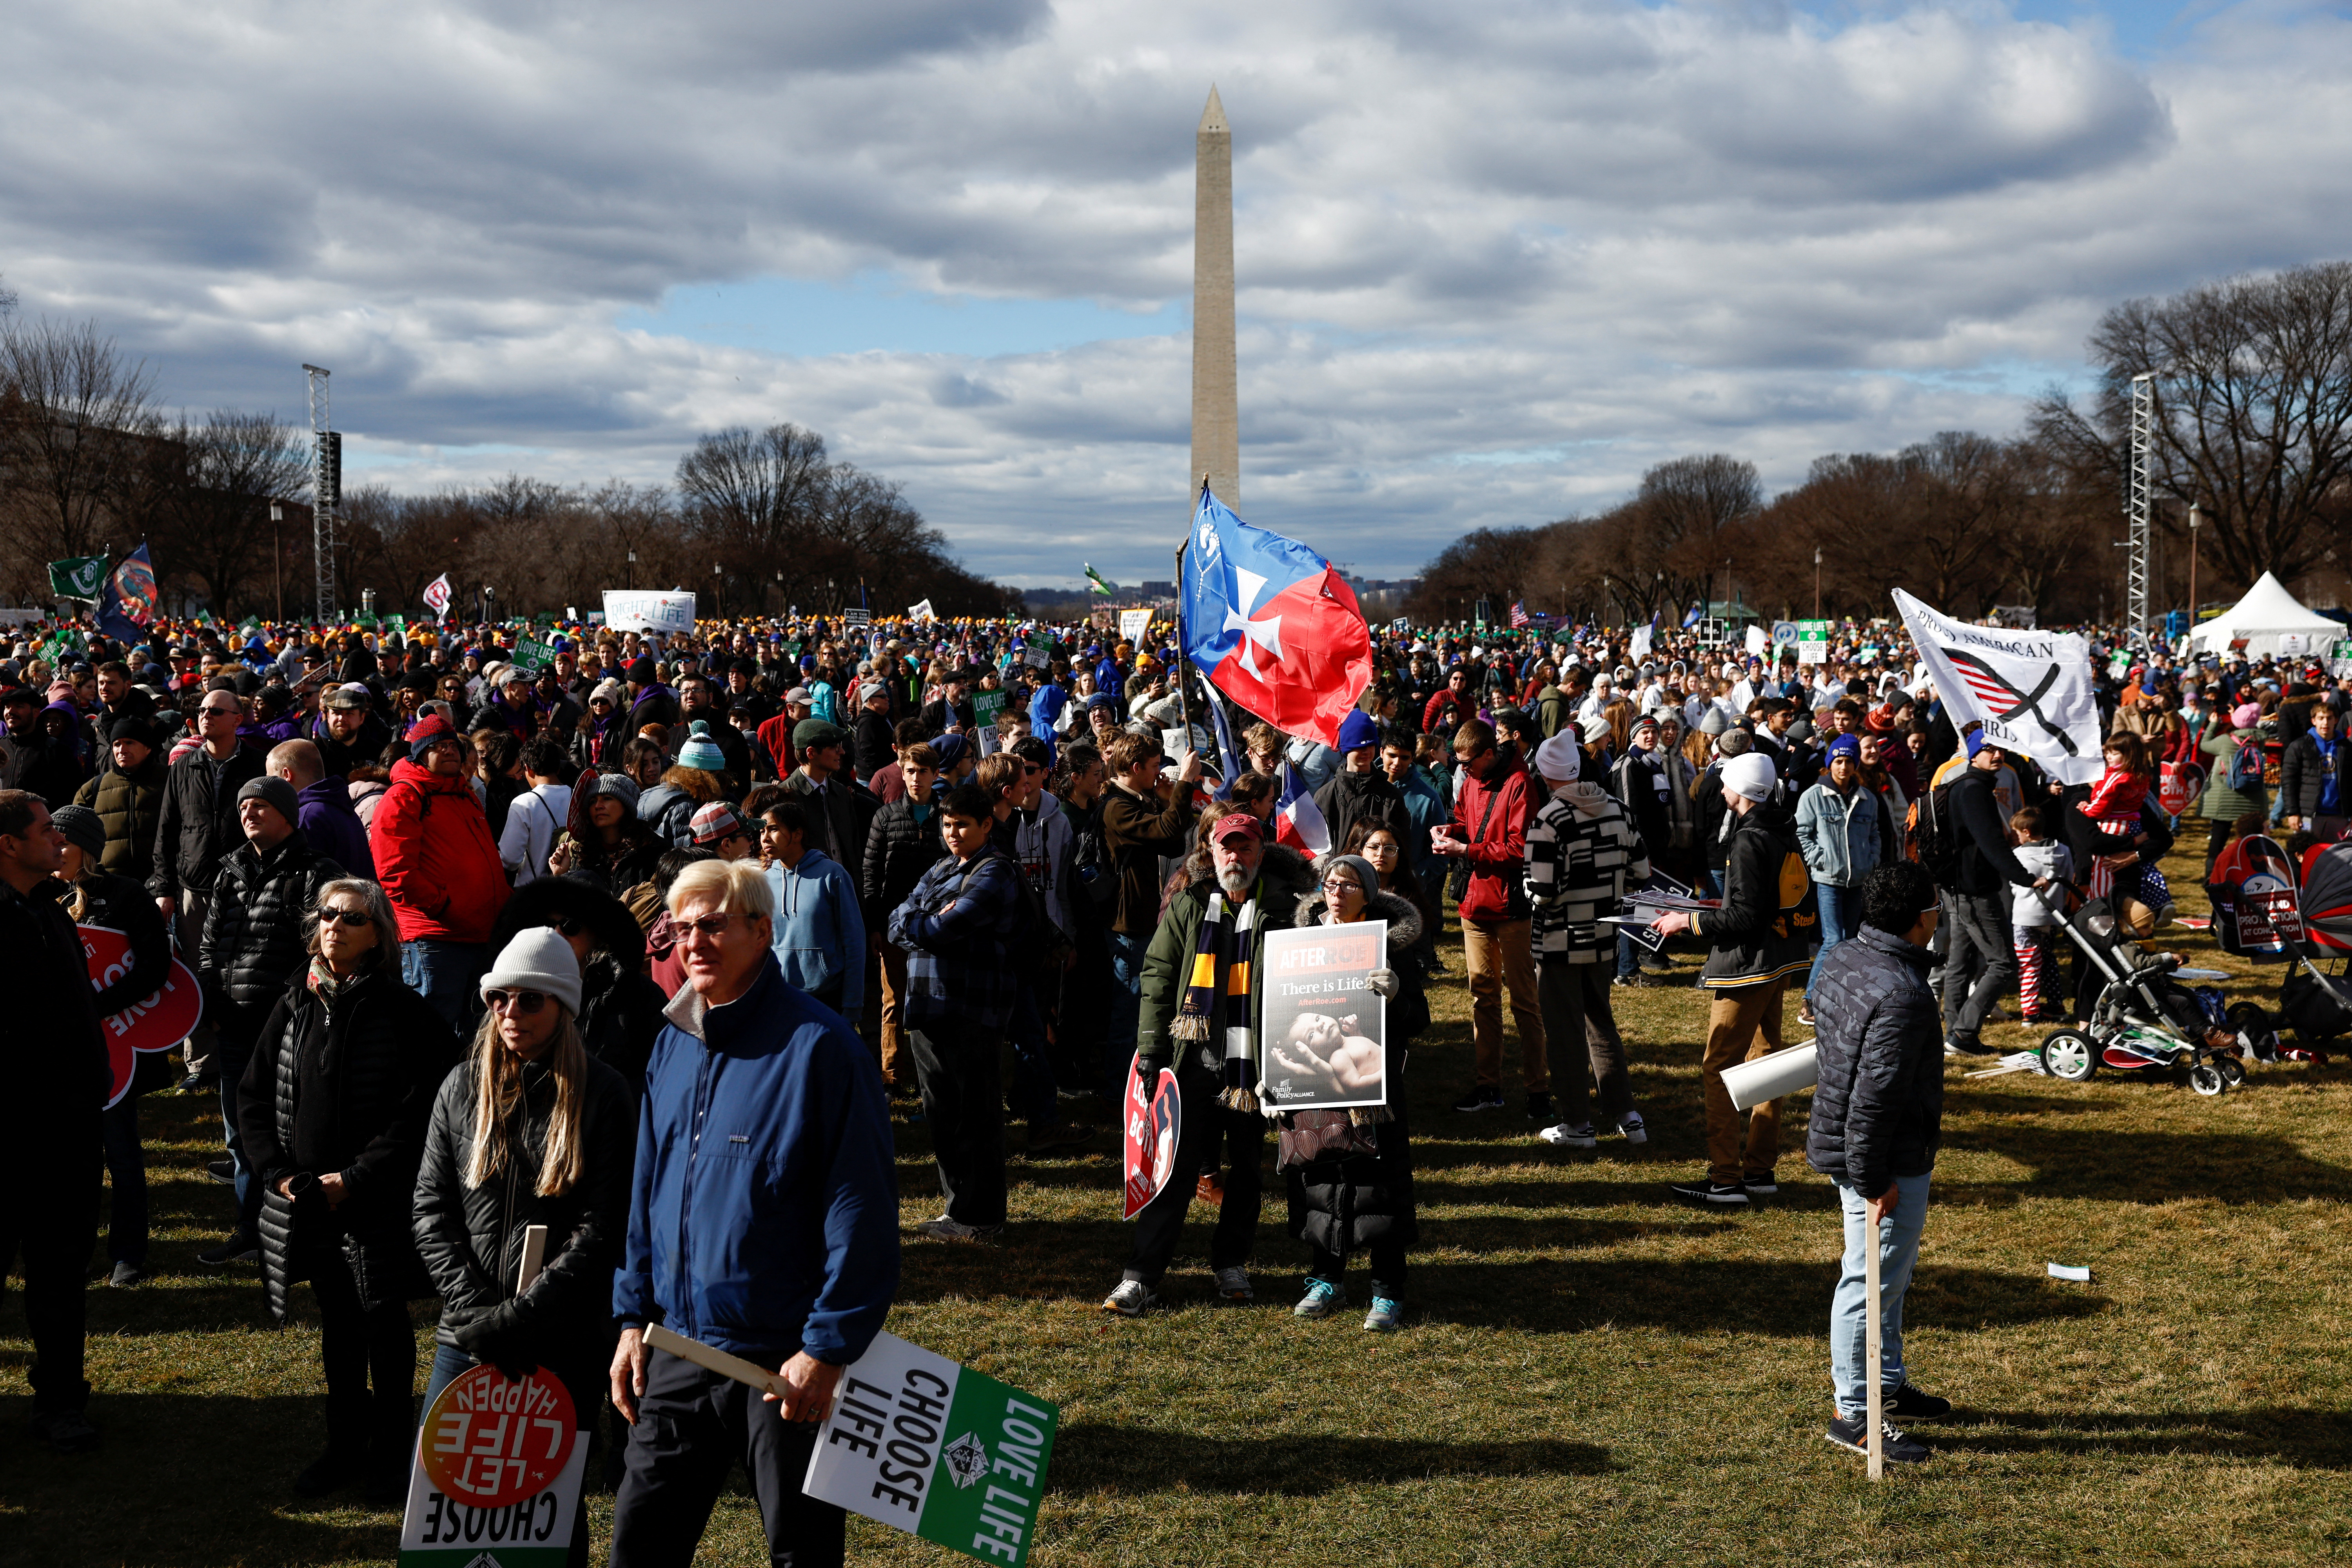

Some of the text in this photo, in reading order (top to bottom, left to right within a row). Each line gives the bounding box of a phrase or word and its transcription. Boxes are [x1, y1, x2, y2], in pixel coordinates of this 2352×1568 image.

[612, 600, 647, 622] RIGHT
[652, 601, 685, 623] LIFE
[1800, 621, 1825, 632] LOVE LIFE
[1918, 610, 1956, 642] PROUD
[1033, 632, 1054, 644] LOVE LIFE
[1803, 643, 1823, 652] CHOOSE
[518, 639, 555, 661] LOVE LIFE
[1029, 648, 1047, 659] CHOOSE
[1808, 653, 1818, 661] LIFE
[1031, 657, 1040, 665] LIFE
[975, 692, 1006, 711] LOVE LIFE
[2160, 786, 2184, 795] OTH
[1487, 792, 1498, 812] DIDAS
[1476, 815, 1489, 841] ADIDAS
[1280, 977, 1367, 996] There is Life.
[1298, 997, 1347, 1007] AfterRoe.com
[1271, 1085, 1292, 1093] Family
[1129, 1111, 1154, 1163] BOTH
[1131, 1163, 1141, 1181] LIVE
[435, 1366, 497, 1414] SAVETHESTORKS.ORG
[456, 1374, 558, 1416] HAPPEN
[829, 1377, 893, 1460] LIFE
[434, 1412, 563, 1459] LIFE
[872, 1369, 949, 1513] CHOOSE
[974, 1450, 982, 1459] K
[453, 1456, 527, 1496] LET
[969, 1469, 976, 1478] C
[972, 1398, 1049, 1563] LOVE LIFE
[422, 1491, 557, 1543] CHOOSE
